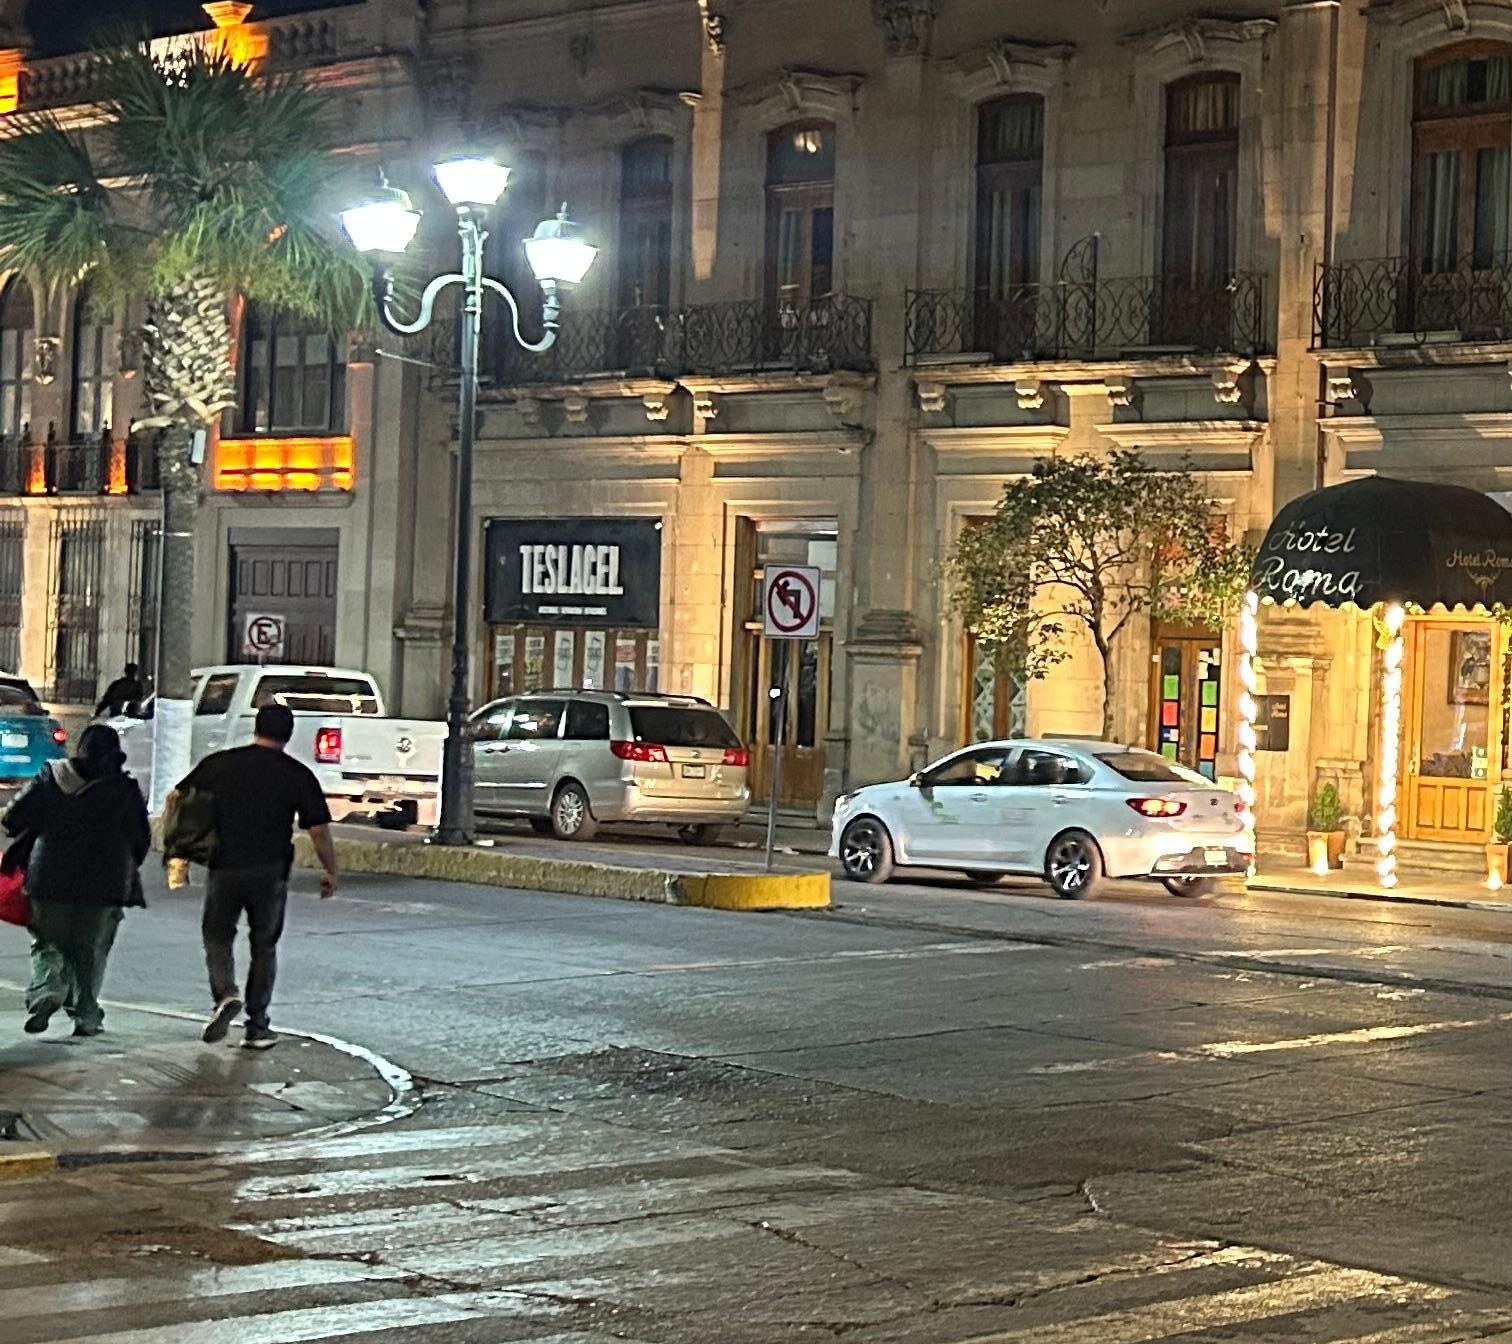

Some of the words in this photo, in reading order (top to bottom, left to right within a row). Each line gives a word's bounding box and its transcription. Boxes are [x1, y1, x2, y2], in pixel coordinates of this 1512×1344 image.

[1268, 520, 1356, 553] Hotel
[519, 544, 624, 595] TESLACEL
[1251, 556, 1364, 595] Roma
[1446, 547, 1481, 568] Hotel
